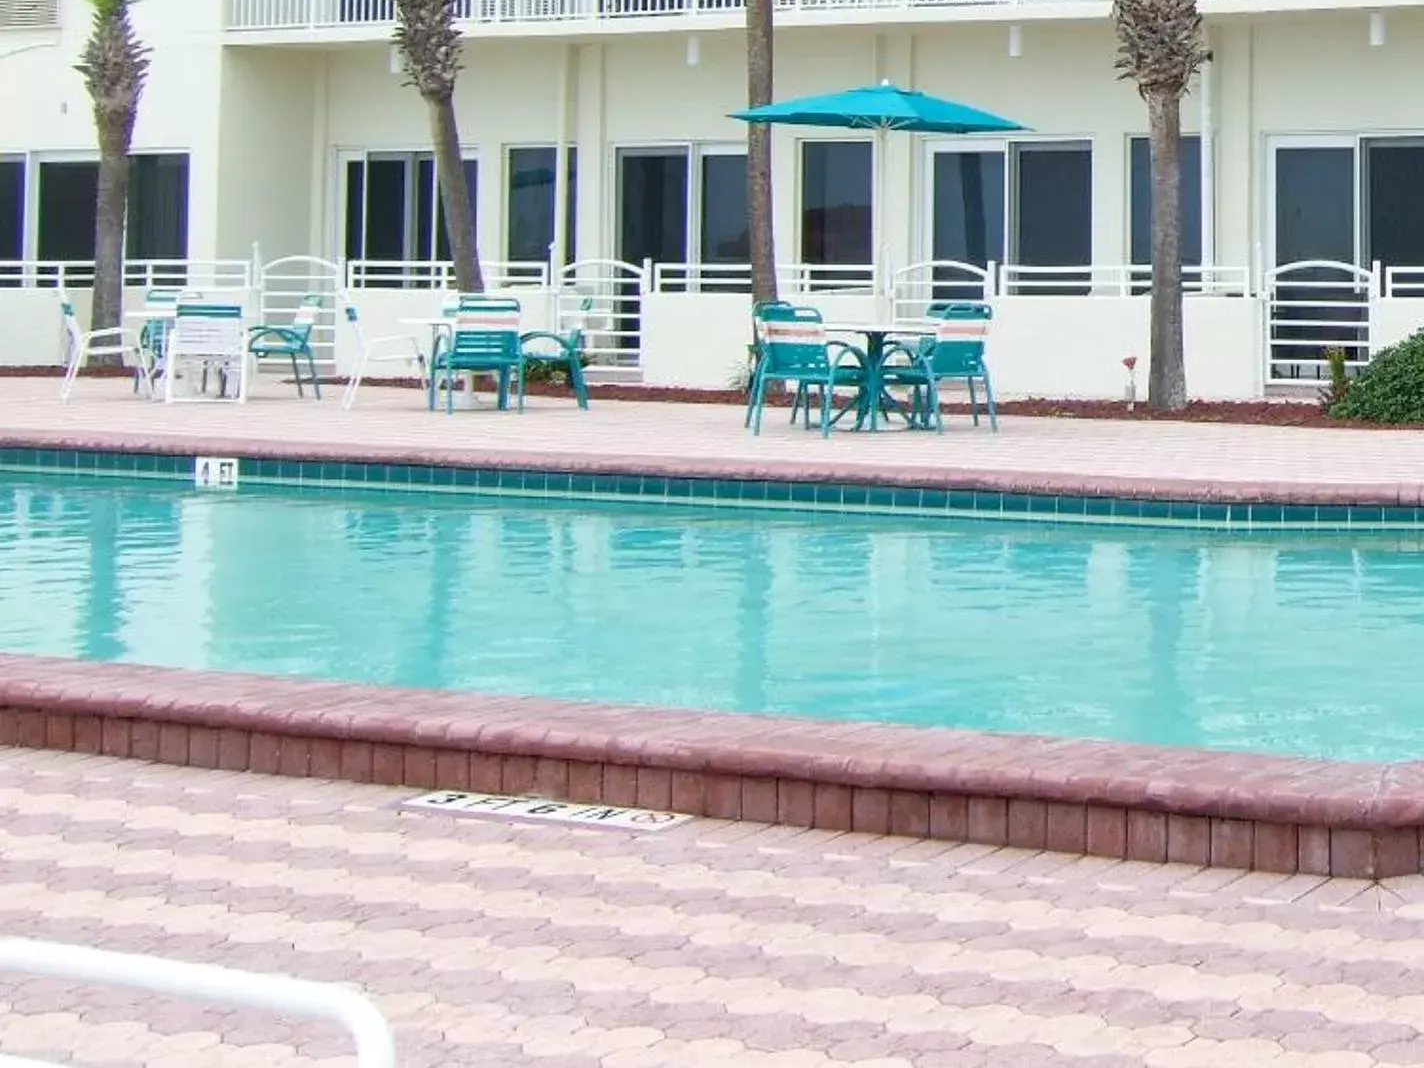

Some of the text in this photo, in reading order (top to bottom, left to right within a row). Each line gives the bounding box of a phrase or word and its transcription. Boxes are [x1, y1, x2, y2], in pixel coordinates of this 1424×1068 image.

[219, 461, 234, 486] FT
[427, 794, 468, 805] 3
[464, 797, 530, 811] FT
[571, 807, 630, 820] IN
